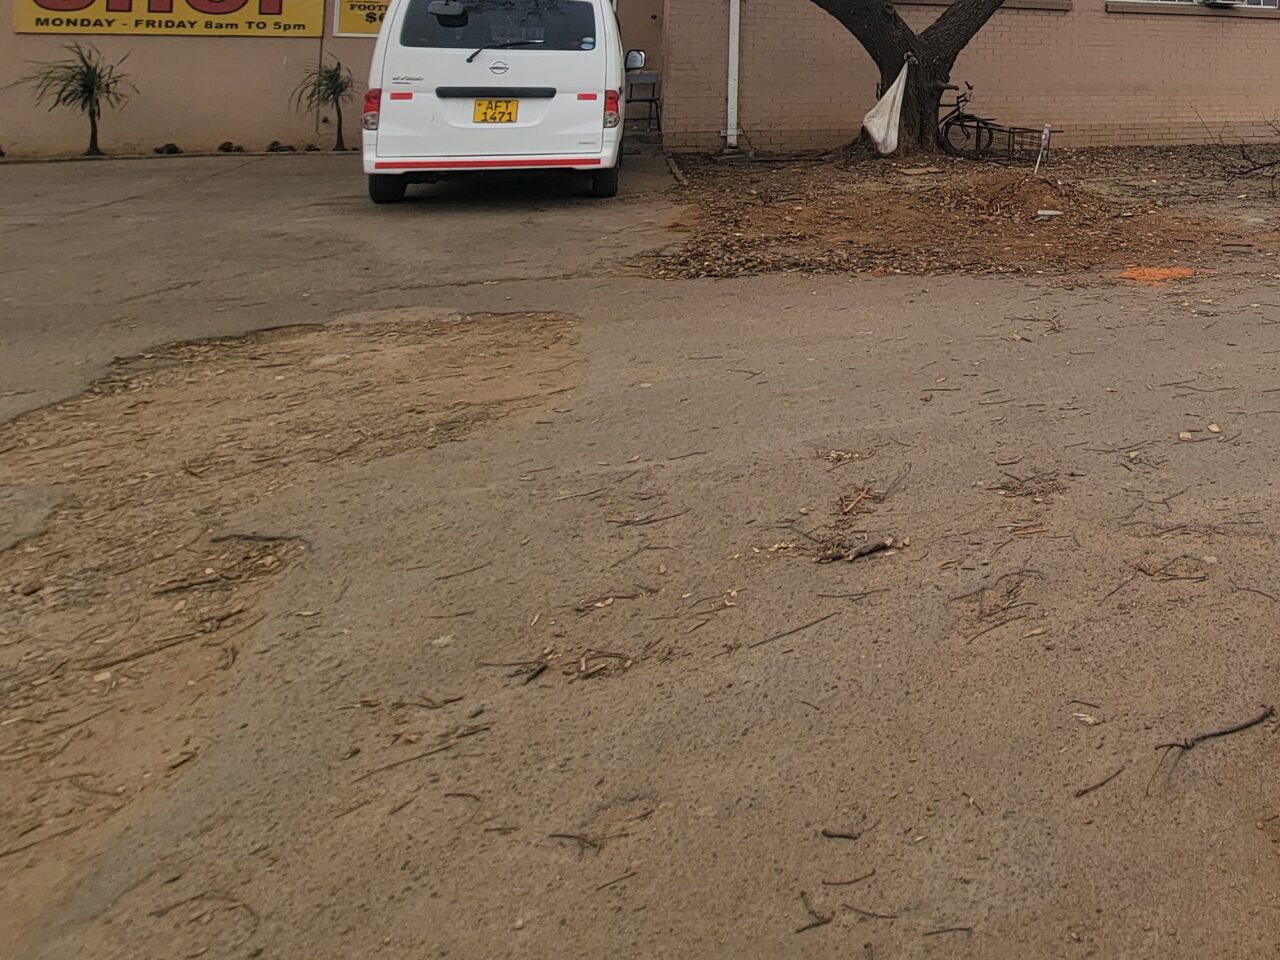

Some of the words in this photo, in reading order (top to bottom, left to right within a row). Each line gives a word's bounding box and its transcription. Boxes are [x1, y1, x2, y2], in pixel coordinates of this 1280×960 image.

[35, 17, 116, 28] MONDAY
[134, 19, 197, 29] FRIDAY
[204, 20, 238, 30] 8am
[245, 21, 266, 30] TO
[273, 21, 306, 31] 5pm
[486, 100, 511, 110] AFT
[481, 112, 512, 121] 1471
